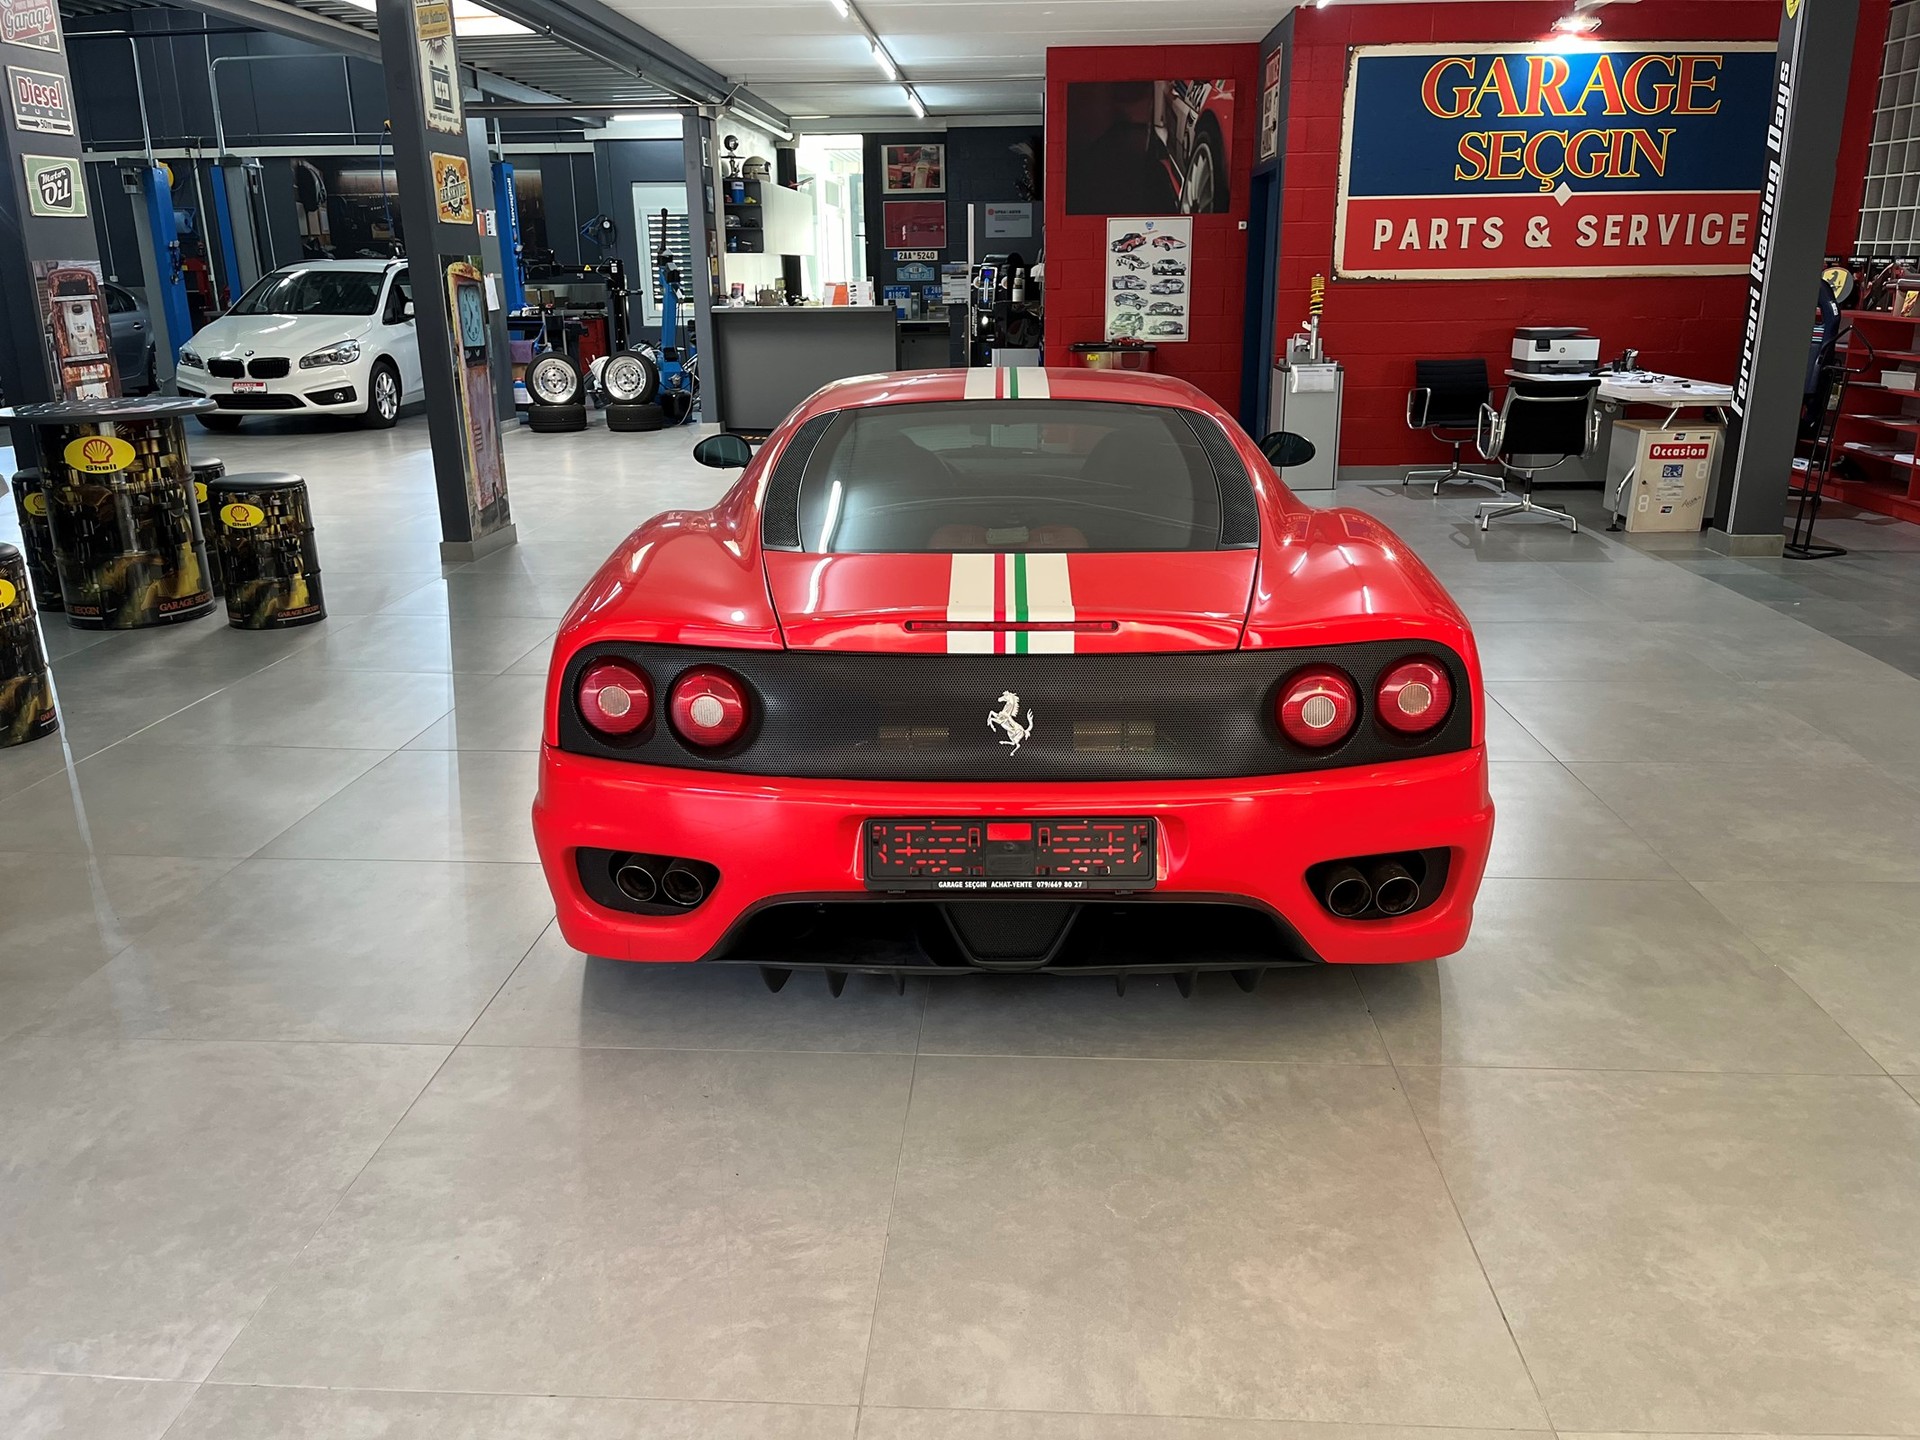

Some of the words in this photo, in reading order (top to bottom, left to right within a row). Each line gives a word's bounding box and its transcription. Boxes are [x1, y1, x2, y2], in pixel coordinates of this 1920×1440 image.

[3, 6, 51, 39] Garage
[16, 76, 64, 110] Diesel
[1421, 54, 1723, 119] GARAGE
[22, 106, 66, 119] FUEL
[1766, 60, 1790, 154] Days
[1454, 128, 1676, 192] SEÇGIN
[41, 169, 67, 184] Motor
[41, 178, 71, 205] Oil
[1372, 215, 1505, 251] PARTS
[1525, 215, 1553, 248] &
[1575, 213, 1750, 248] SERVICE
[1751, 159, 1782, 283] Racing
[899, 252, 912, 260] 2AA
[917, 251, 935, 260] 5240
[1731, 286, 1761, 418] Ferrari
[1653, 445, 1705, 456] Occasion
[85, 463, 117, 472] Shell
[159, 598, 194, 612] GARAGE
[964, 881, 987, 889] SEÇGIN
[1036, 881, 1063, 889] 079/669
